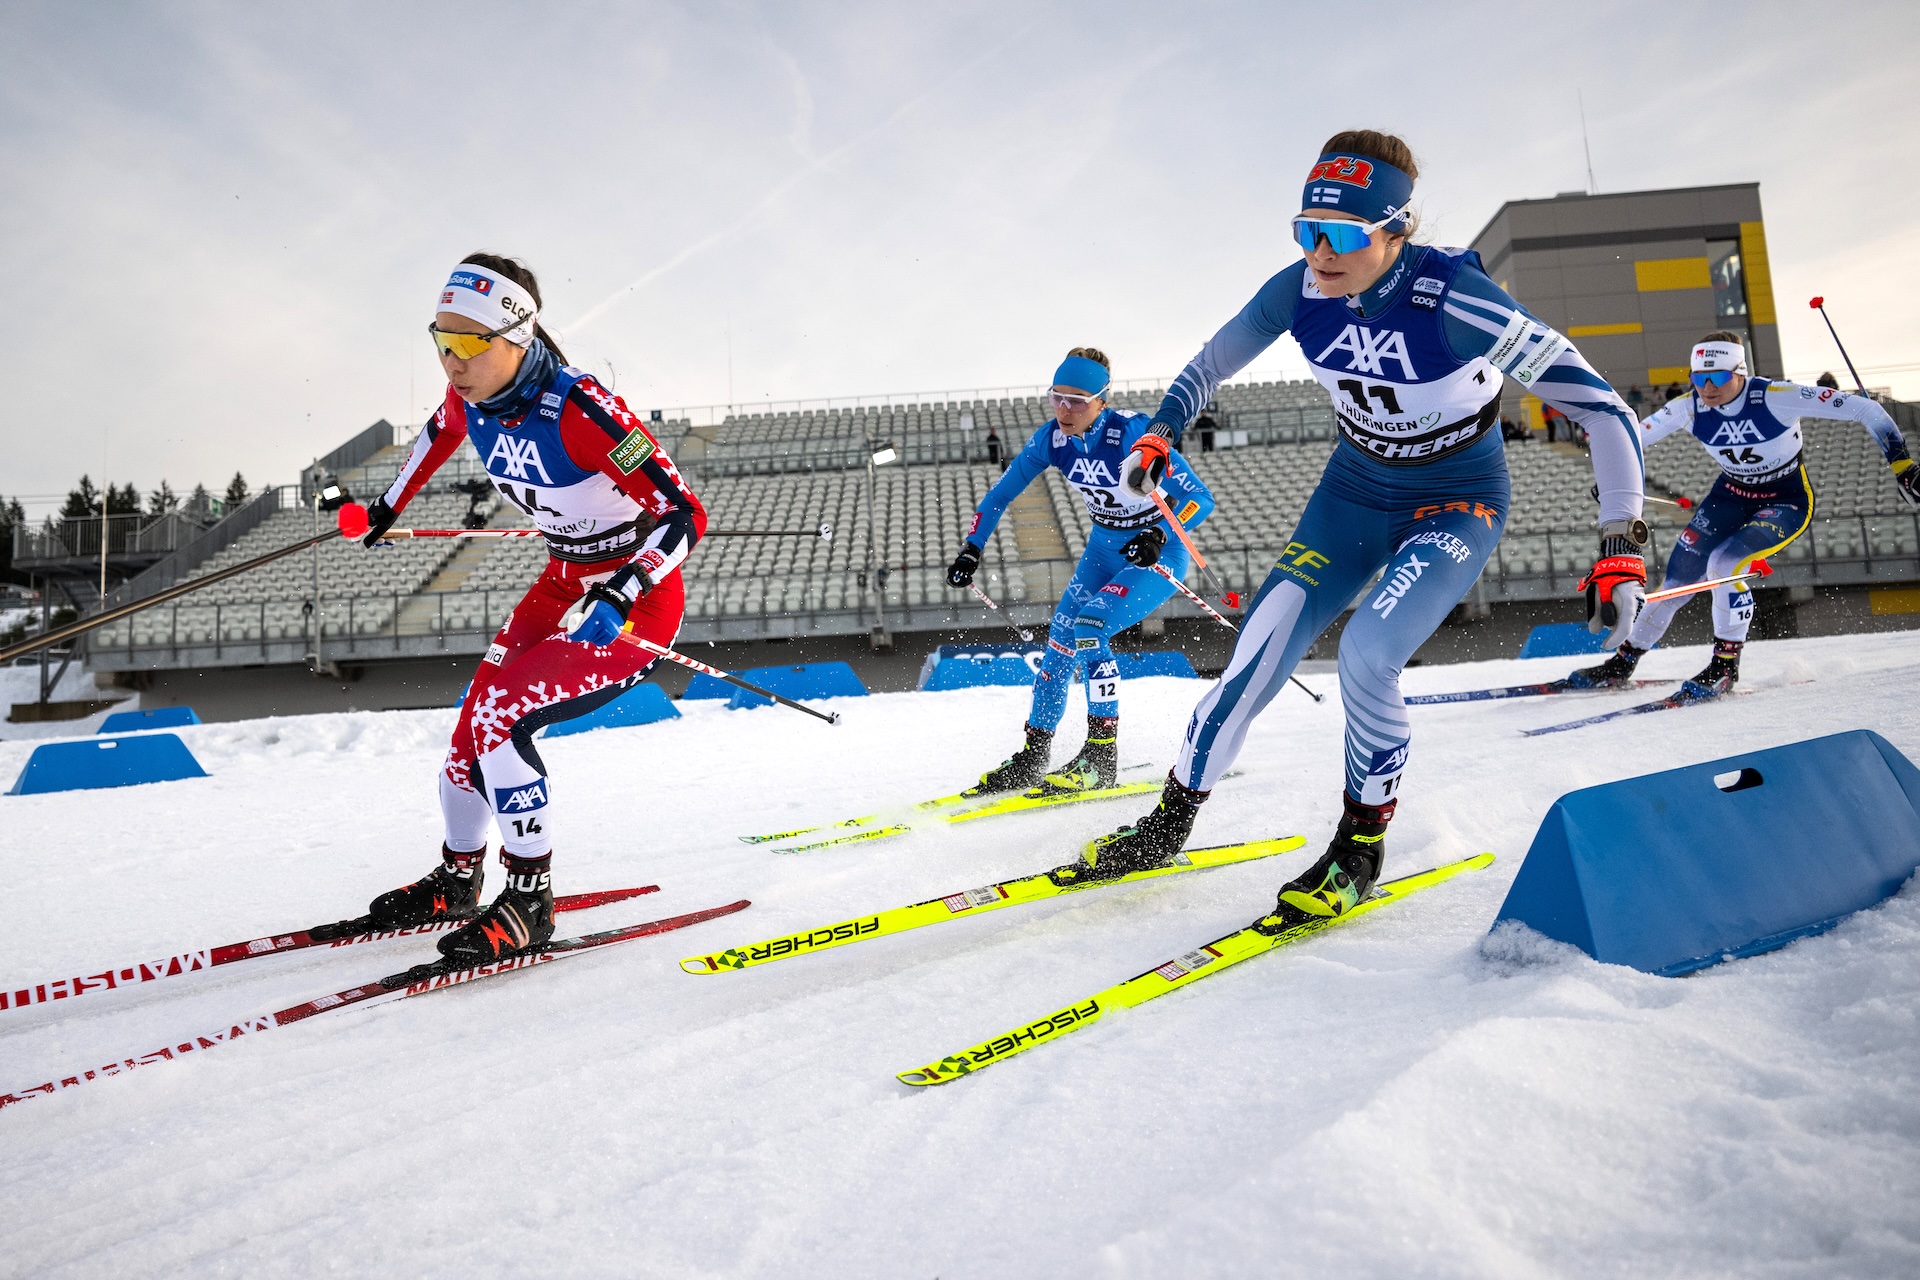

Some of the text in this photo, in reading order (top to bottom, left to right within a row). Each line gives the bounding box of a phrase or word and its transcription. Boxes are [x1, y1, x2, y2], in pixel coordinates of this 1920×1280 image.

[450, 275, 476, 287] Bank
[1412, 295, 1437, 308] coop
[1314, 323, 1420, 381] AXA
[1473, 369, 1486, 385] 1
[1337, 379, 1405, 415] 11
[1709, 419, 1767, 445] AXA
[486, 433, 555, 485] AXA
[616, 433, 643, 460] MESTER
[623, 441, 651, 468] GRØNN
[1719, 447, 1764, 465] 16
[1067, 458, 1118, 485] AXA
[1414, 536, 1466, 564] SPORT
[1421, 531, 1471, 557] INTER
[645, 550, 664, 566] NOR
[1738, 609, 1751, 621] 16
[1092, 661, 1119, 679] AXA
[1098, 682, 1116, 697] 12
[501, 785, 547, 811] AXA
[512, 817, 543, 837] 14
[750, 916, 879, 961] FISCHER
[972, 999, 1101, 1064] FISCHER
